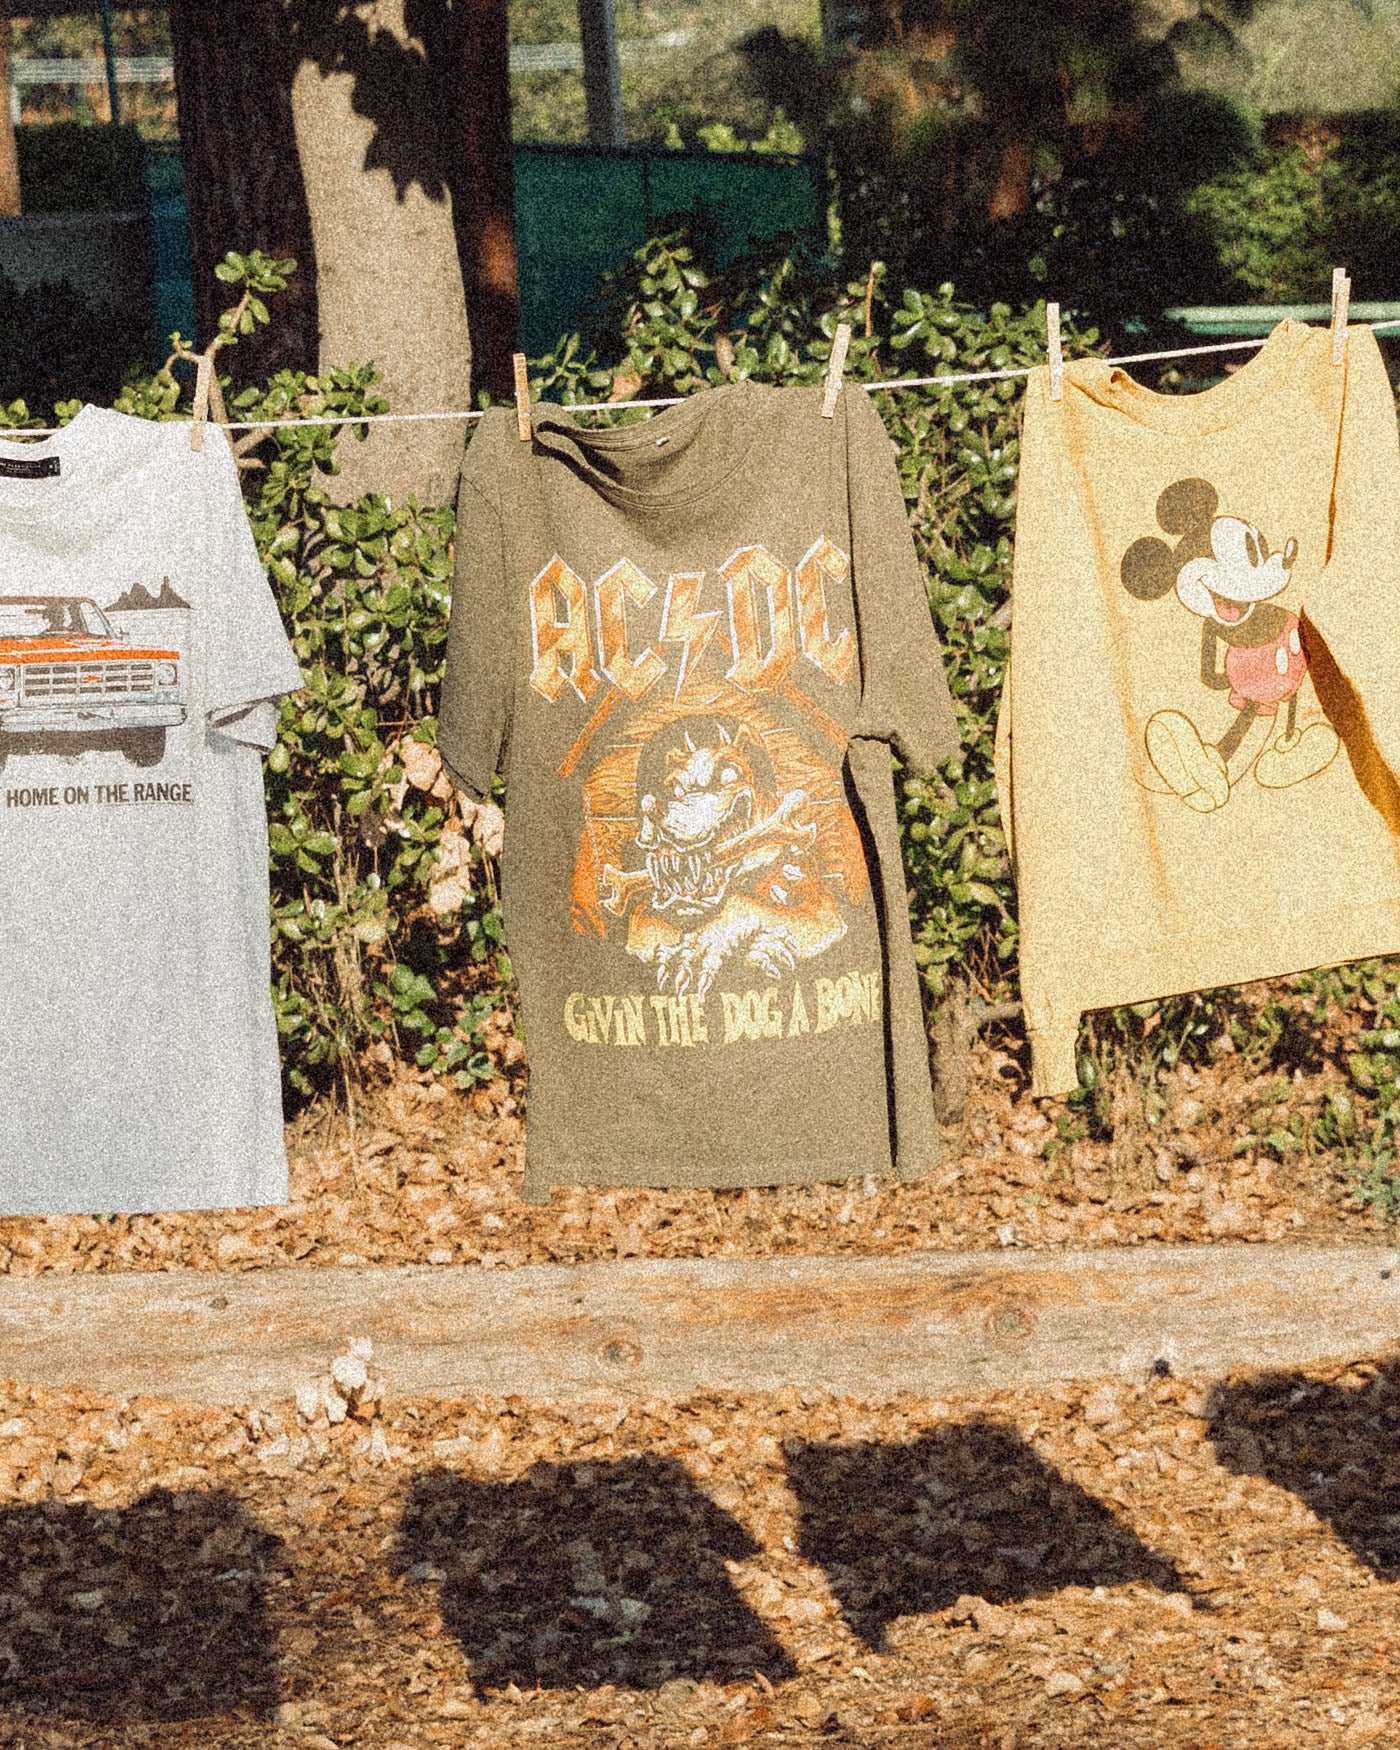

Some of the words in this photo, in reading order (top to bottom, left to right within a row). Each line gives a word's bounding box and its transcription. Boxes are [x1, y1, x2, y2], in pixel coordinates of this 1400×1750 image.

[6, 787, 59, 808] HOME
[64, 786, 89, 805] ON
[94, 784, 129, 803] THE
[133, 783, 192, 803] RANGE
[650, 993, 709, 1047] THE
[721, 986, 783, 1045] DOG
[786, 980, 811, 1039] A
